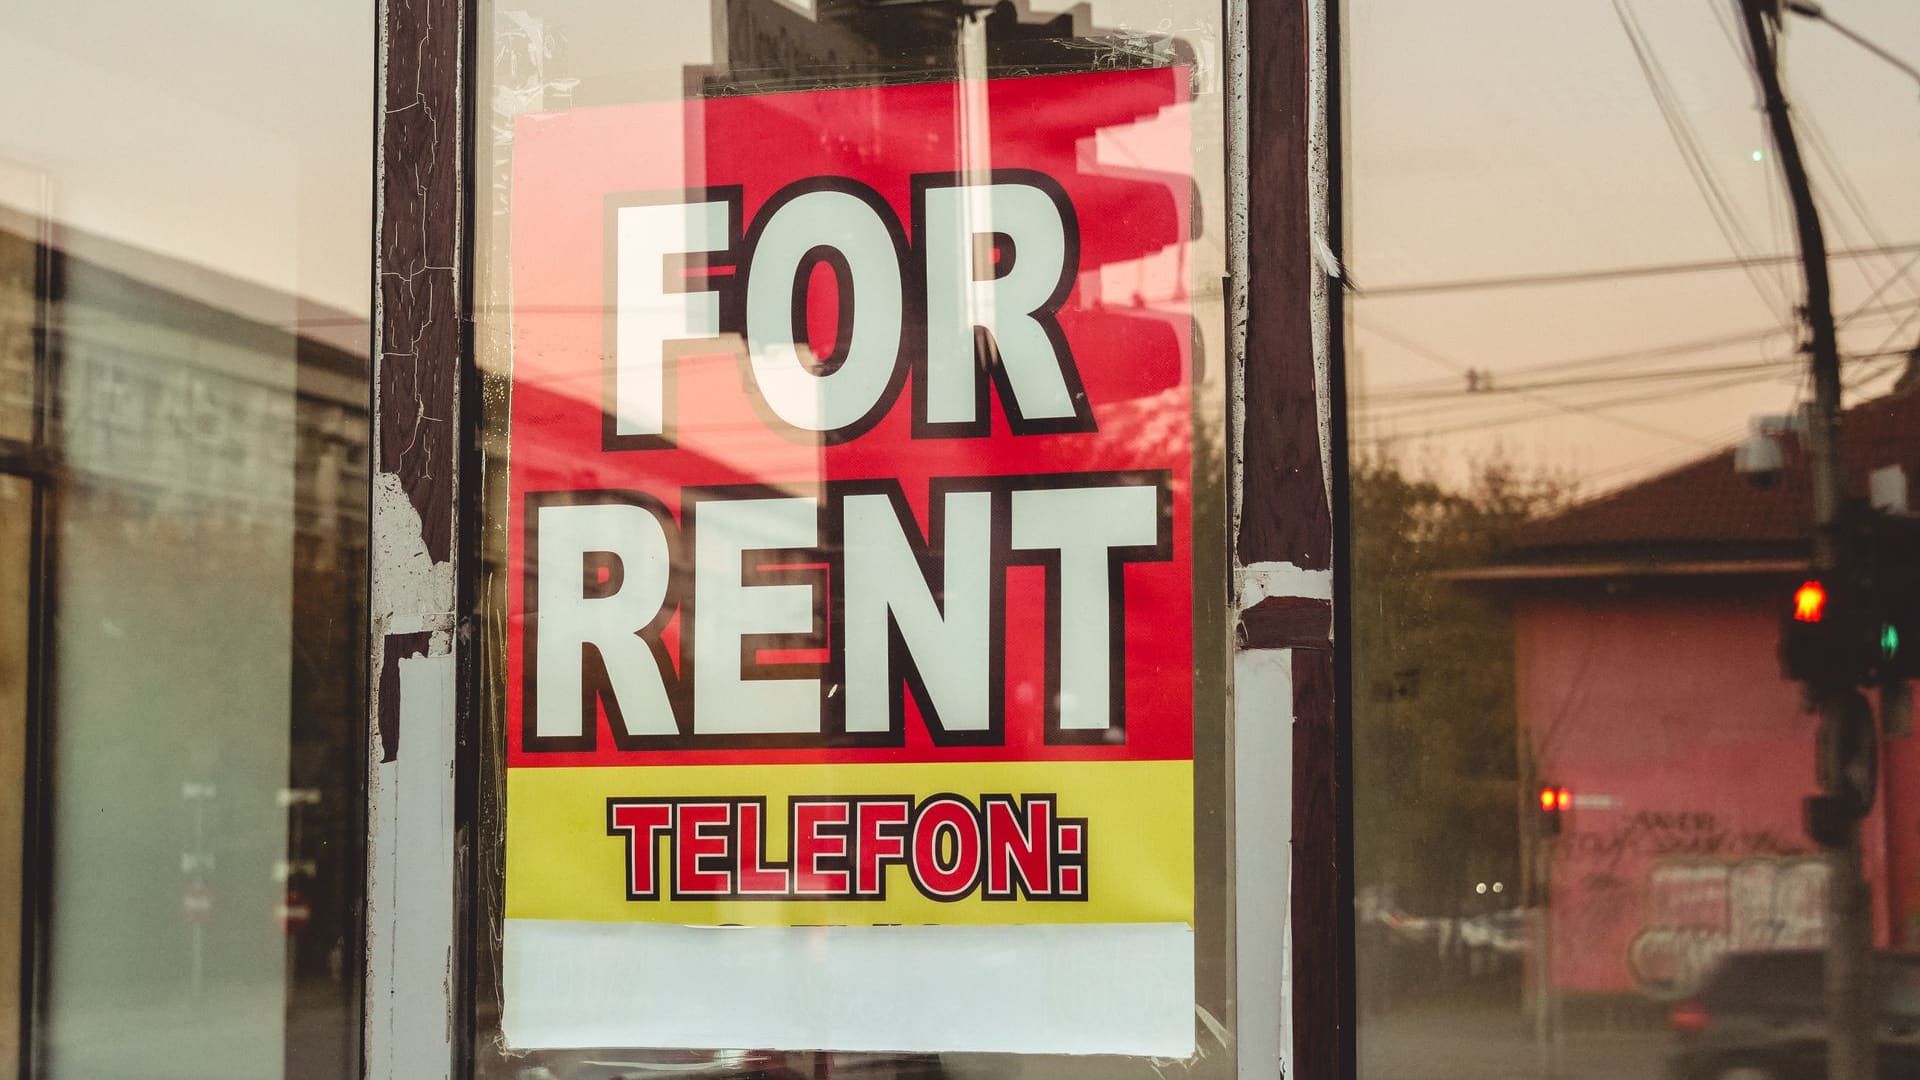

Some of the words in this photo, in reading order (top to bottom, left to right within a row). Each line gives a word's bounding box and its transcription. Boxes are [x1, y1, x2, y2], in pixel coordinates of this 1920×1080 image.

[603, 169, 1097, 452] FOR
[522, 469, 1173, 752] RENT
[607, 793, 1088, 902] TELEFON:
